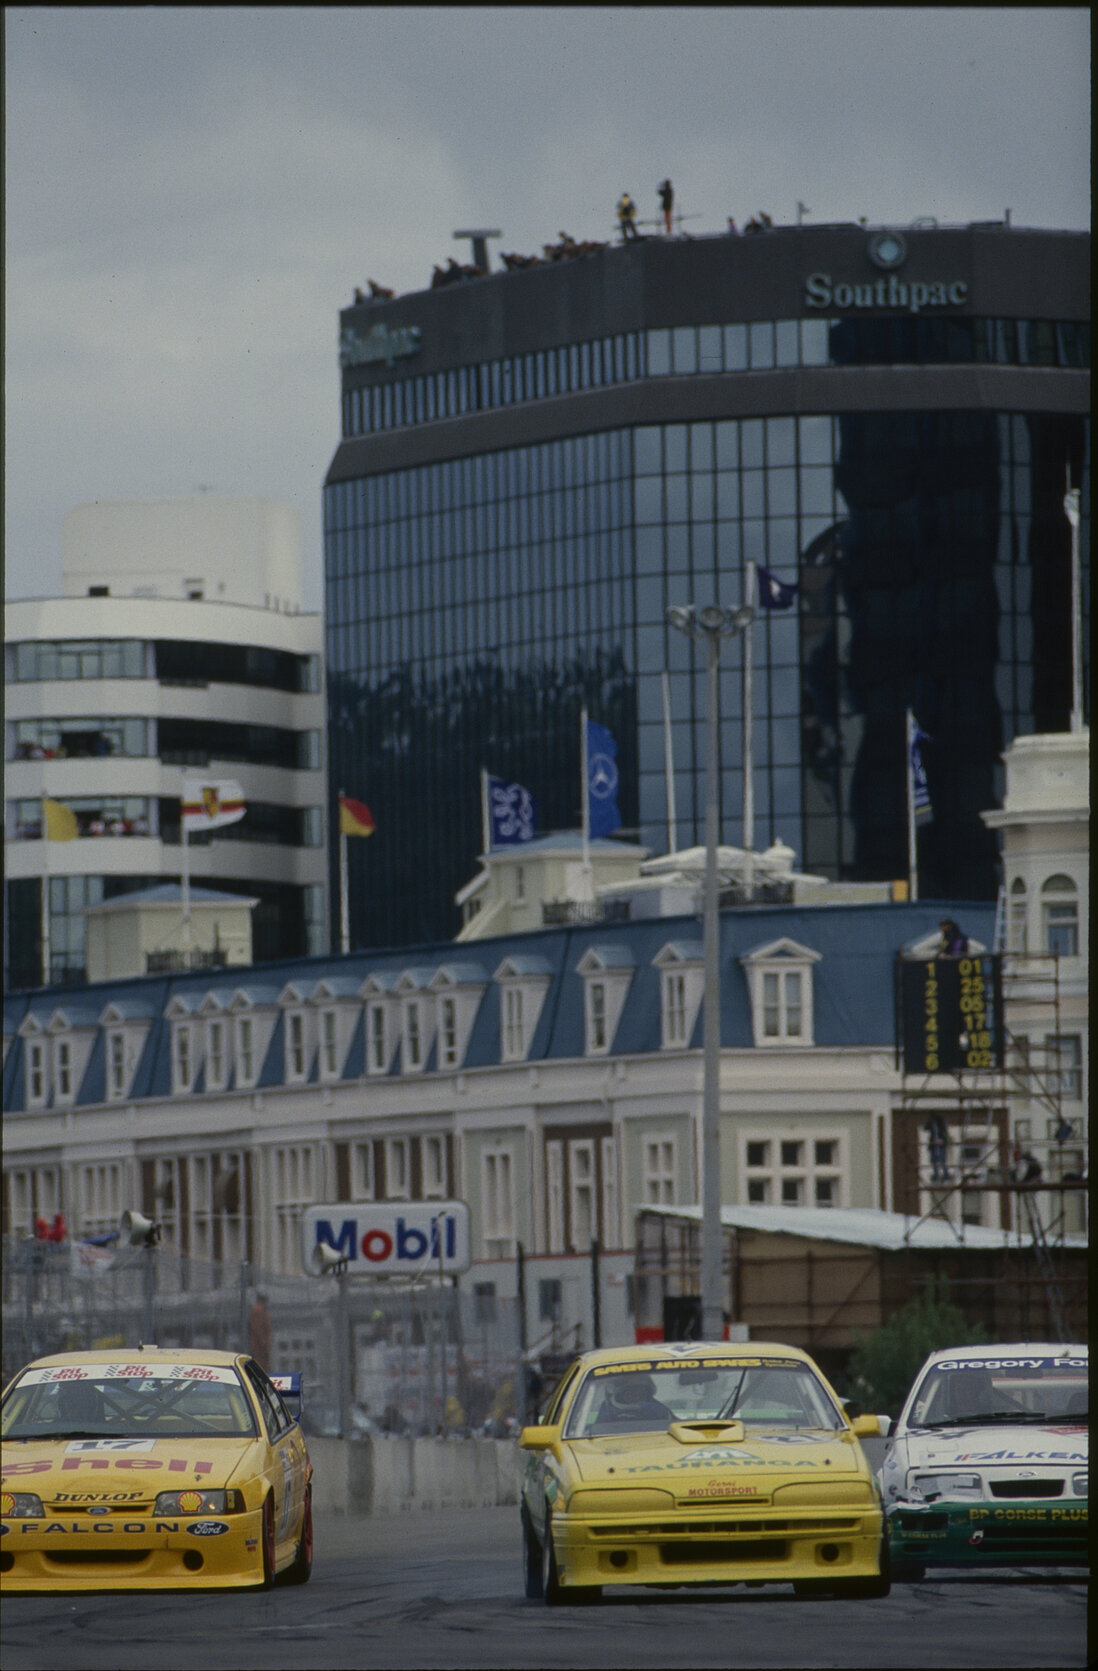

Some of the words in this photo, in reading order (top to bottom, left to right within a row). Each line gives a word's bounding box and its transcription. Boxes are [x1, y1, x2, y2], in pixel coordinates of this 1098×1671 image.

[805, 273, 967, 313] Southpac
[925, 962, 936, 977] 1
[958, 959, 982, 977] 01
[925, 980, 938, 997] 2
[925, 998, 938, 1015] 3
[924, 1016, 938, 1032] 4
[964, 1013, 986, 1030] 17
[925, 1033, 938, 1051] 5
[925, 1053, 939, 1070] 6
[316, 1217, 456, 1262] Mobil
[655, 1360, 700, 1370] AUTO
[702, 1359, 762, 1367] SPARES
[937, 1359, 1044, 1370] Gregory
[51, 1372, 88, 1380] Stop
[116, 1370, 153, 1378] Stop
[182, 1371, 220, 1381] Stop
[72, 1440, 148, 1451] 17
[1, 1457, 213, 1476] Shell
[622, 1460, 818, 1473] TAURANGA
[53, 1492, 144, 1501] DUNLOP
[688, 1486, 758, 1497] MOTORSPORT
[994, 1509, 1047, 1520] CORSE
[22, 1523, 179, 1533] FALCON
[193, 1521, 222, 1535] Ford
